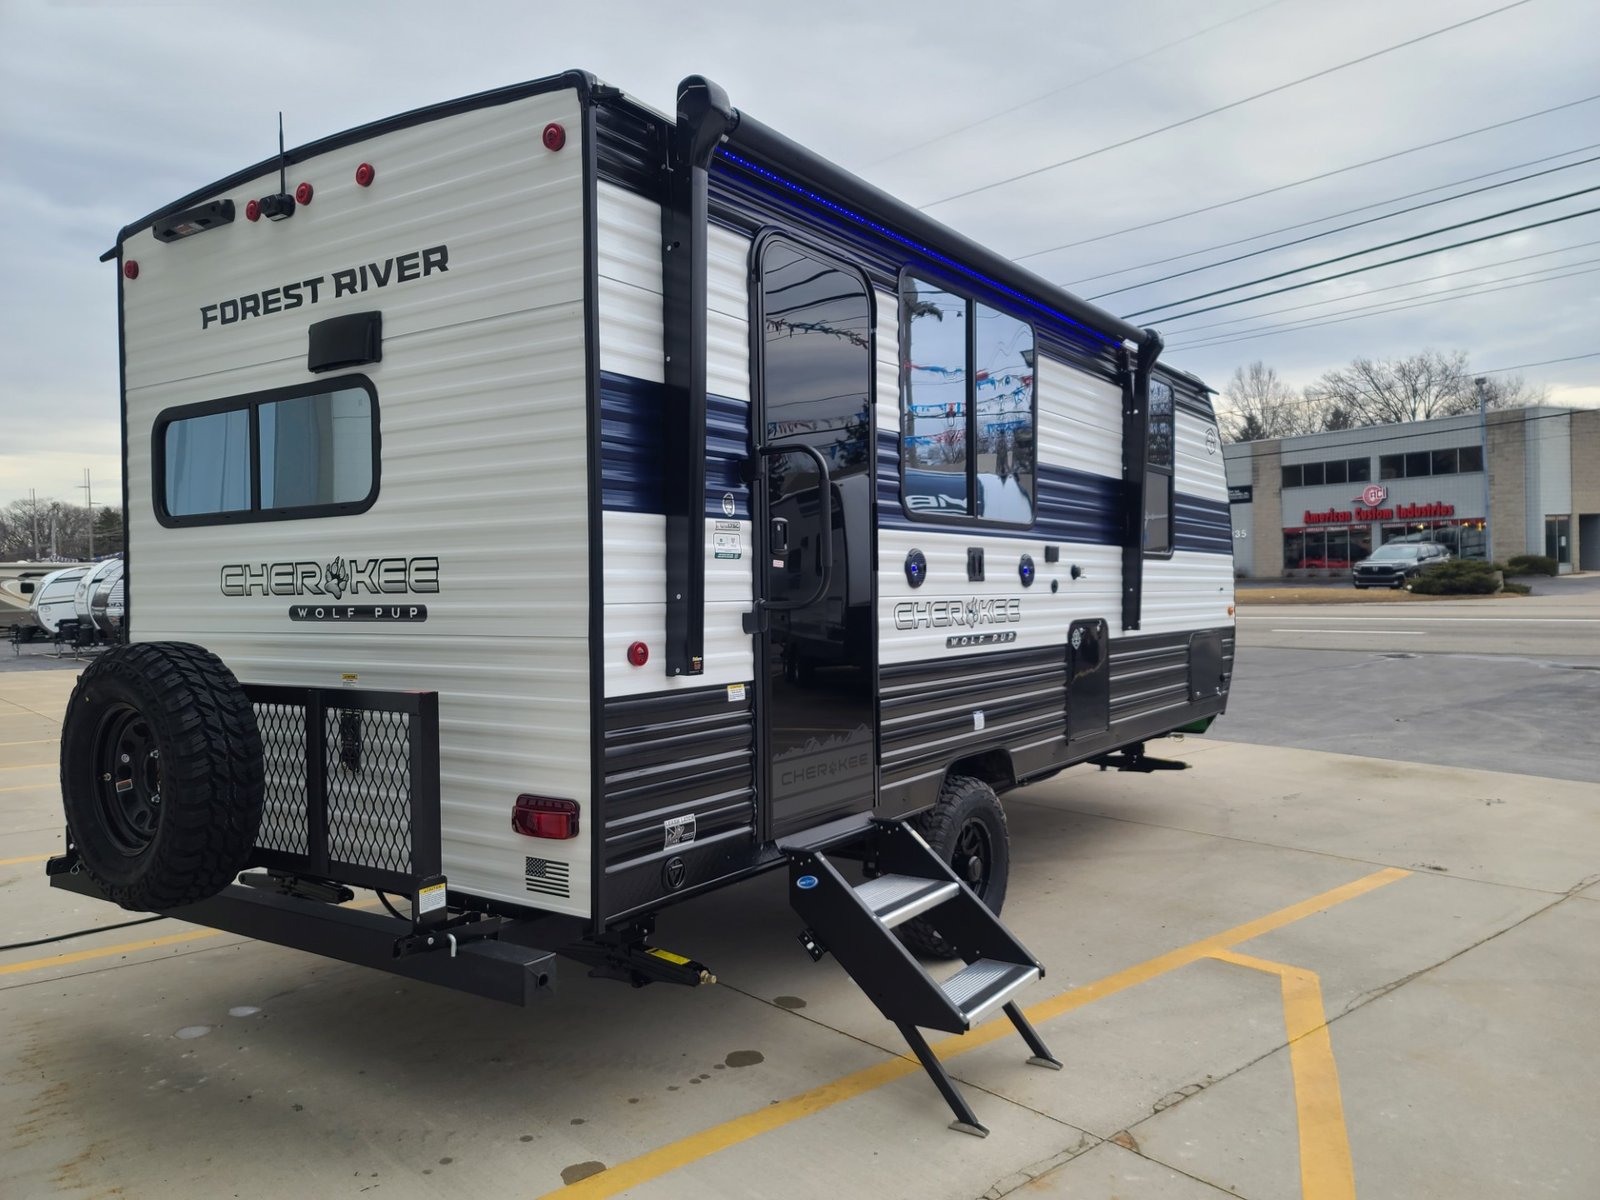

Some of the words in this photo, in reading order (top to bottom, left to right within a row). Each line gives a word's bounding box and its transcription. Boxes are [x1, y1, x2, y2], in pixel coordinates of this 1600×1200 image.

[200, 276, 324, 330] FOREST
[331, 244, 449, 298] RIVER
[1304, 507, 1352, 524] American
[1354, 507, 1393, 521] Custom
[1396, 501, 1455, 519] Industries
[1232, 529, 1247, 538] 35
[298, 607, 355, 618] WOLF
[375, 607, 418, 618] PUP
[950, 635, 985, 646] WOLF
[992, 632, 1015, 642] PUP
